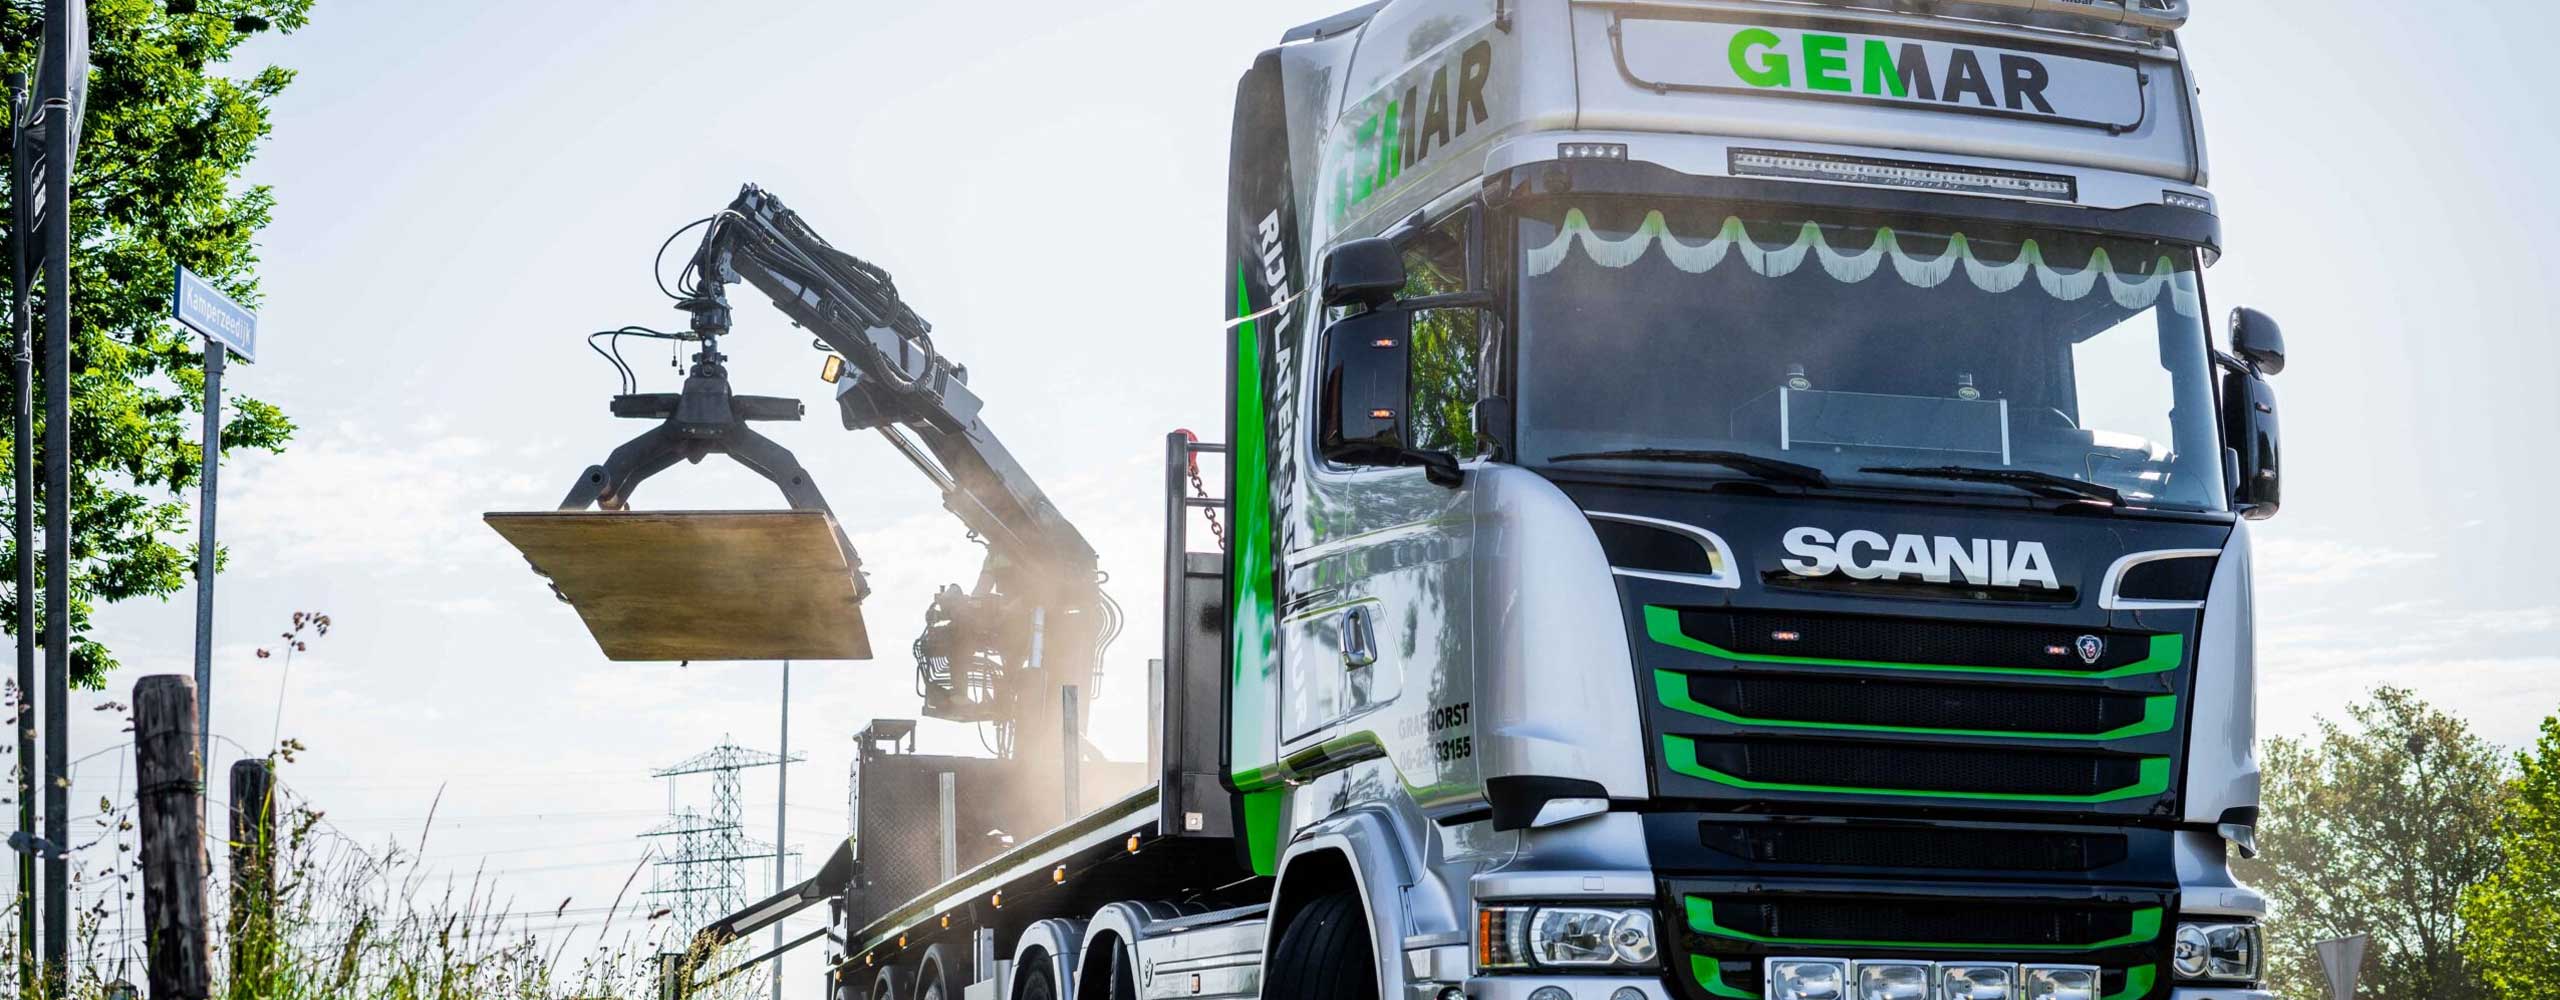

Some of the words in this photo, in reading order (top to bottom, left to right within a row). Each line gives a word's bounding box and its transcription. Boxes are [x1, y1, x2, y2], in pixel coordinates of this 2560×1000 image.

[1728, 28, 2056, 114] GEMAR
[186, 283, 251, 347] Kamperzeedijk
[1781, 526, 2060, 589] SCANIA
[1399, 702, 1469, 739] GRAFHORST
